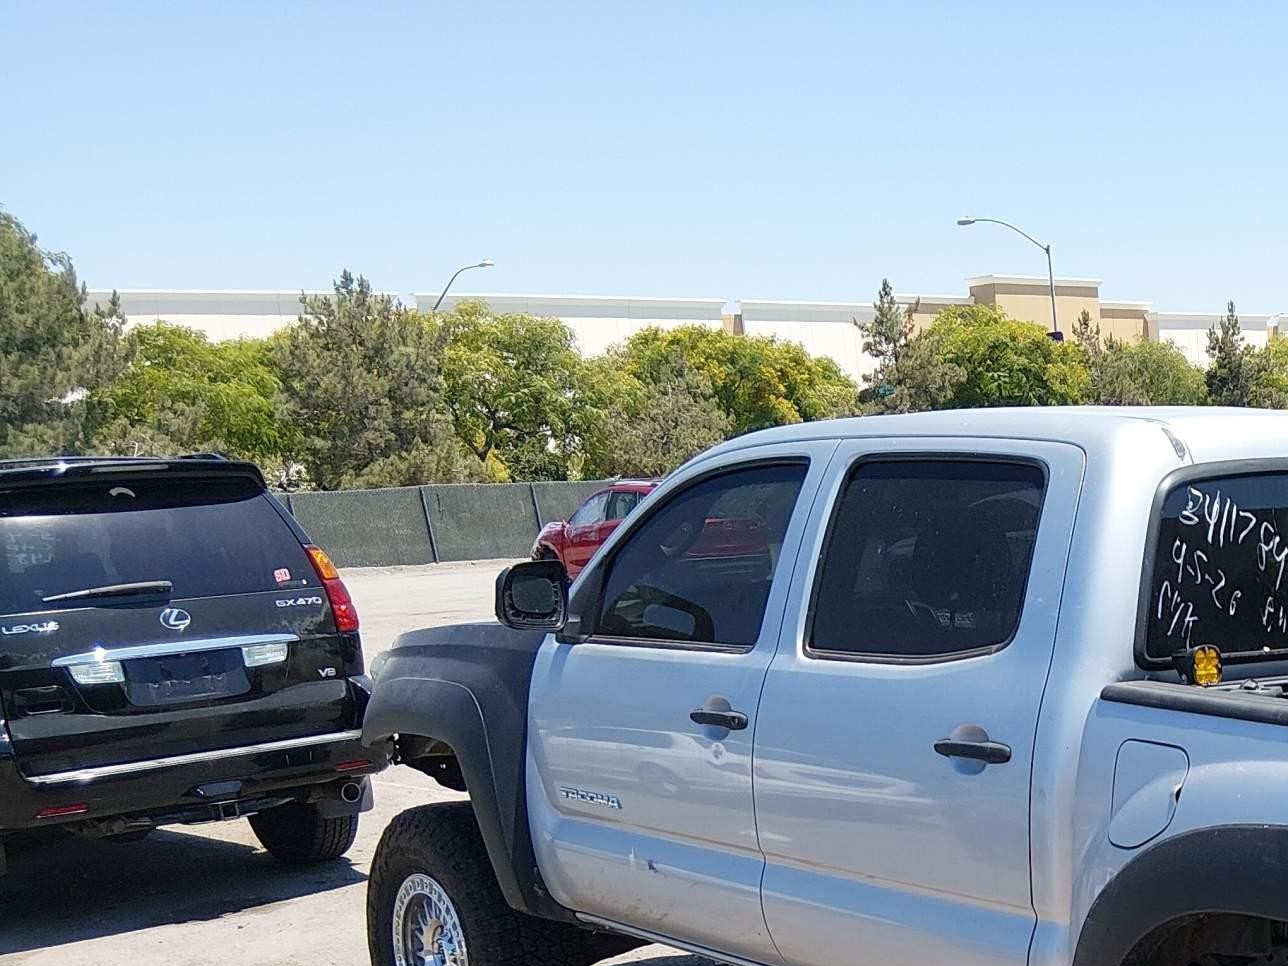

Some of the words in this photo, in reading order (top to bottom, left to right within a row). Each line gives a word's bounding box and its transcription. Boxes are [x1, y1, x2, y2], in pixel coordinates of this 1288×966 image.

[2, 621, 60, 634] LEXUS
[318, 667, 337, 677] V8
[560, 786, 623, 809] TACOMA
